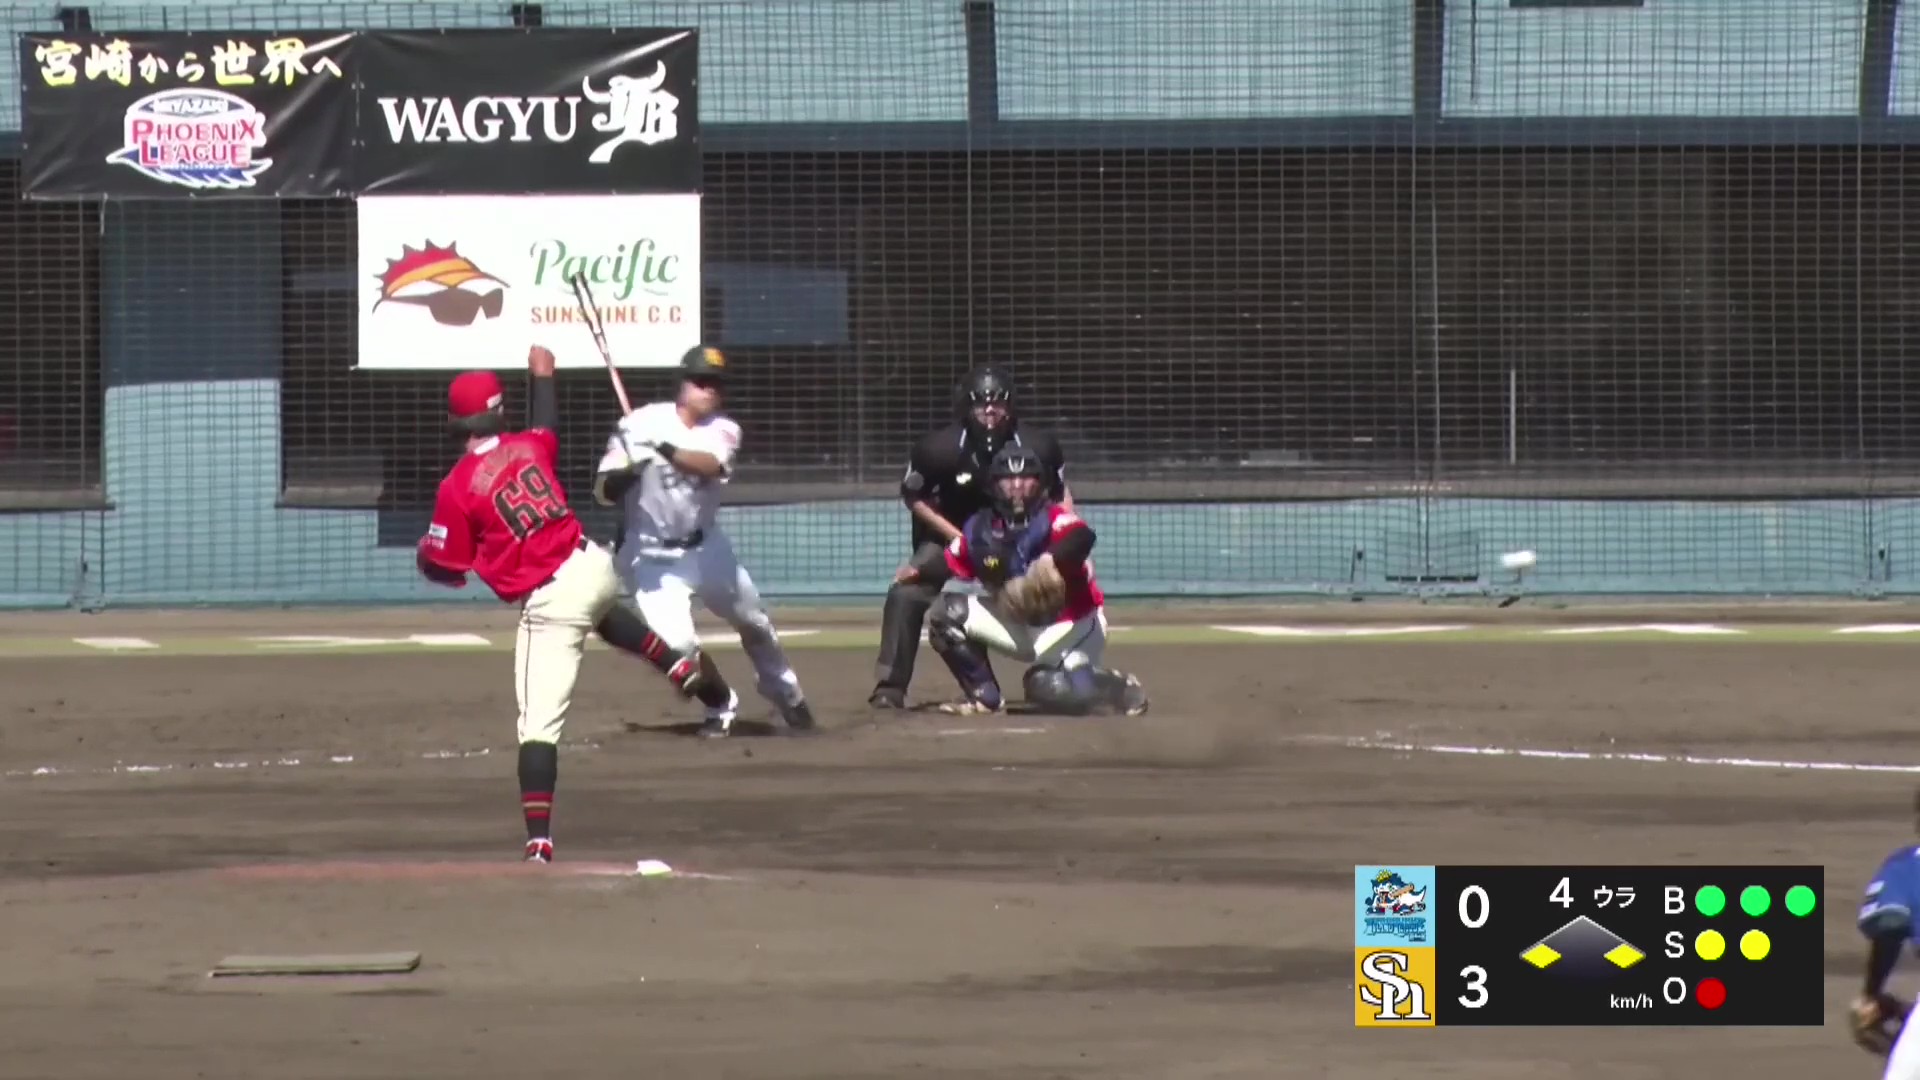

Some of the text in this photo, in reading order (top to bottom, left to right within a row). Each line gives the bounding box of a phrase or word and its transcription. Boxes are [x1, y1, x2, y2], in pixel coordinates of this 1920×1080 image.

[35, 38, 342, 87] 宮崎から世界へ
[132, 119, 257, 144] PHOENIX
[377, 97, 582, 143] WAGYU
[140, 140, 250, 167] LEAGUE
[530, 238, 679, 300] Pacific
[531, 305, 638, 324] SUNSINE
[493, 463, 568, 542] 69
